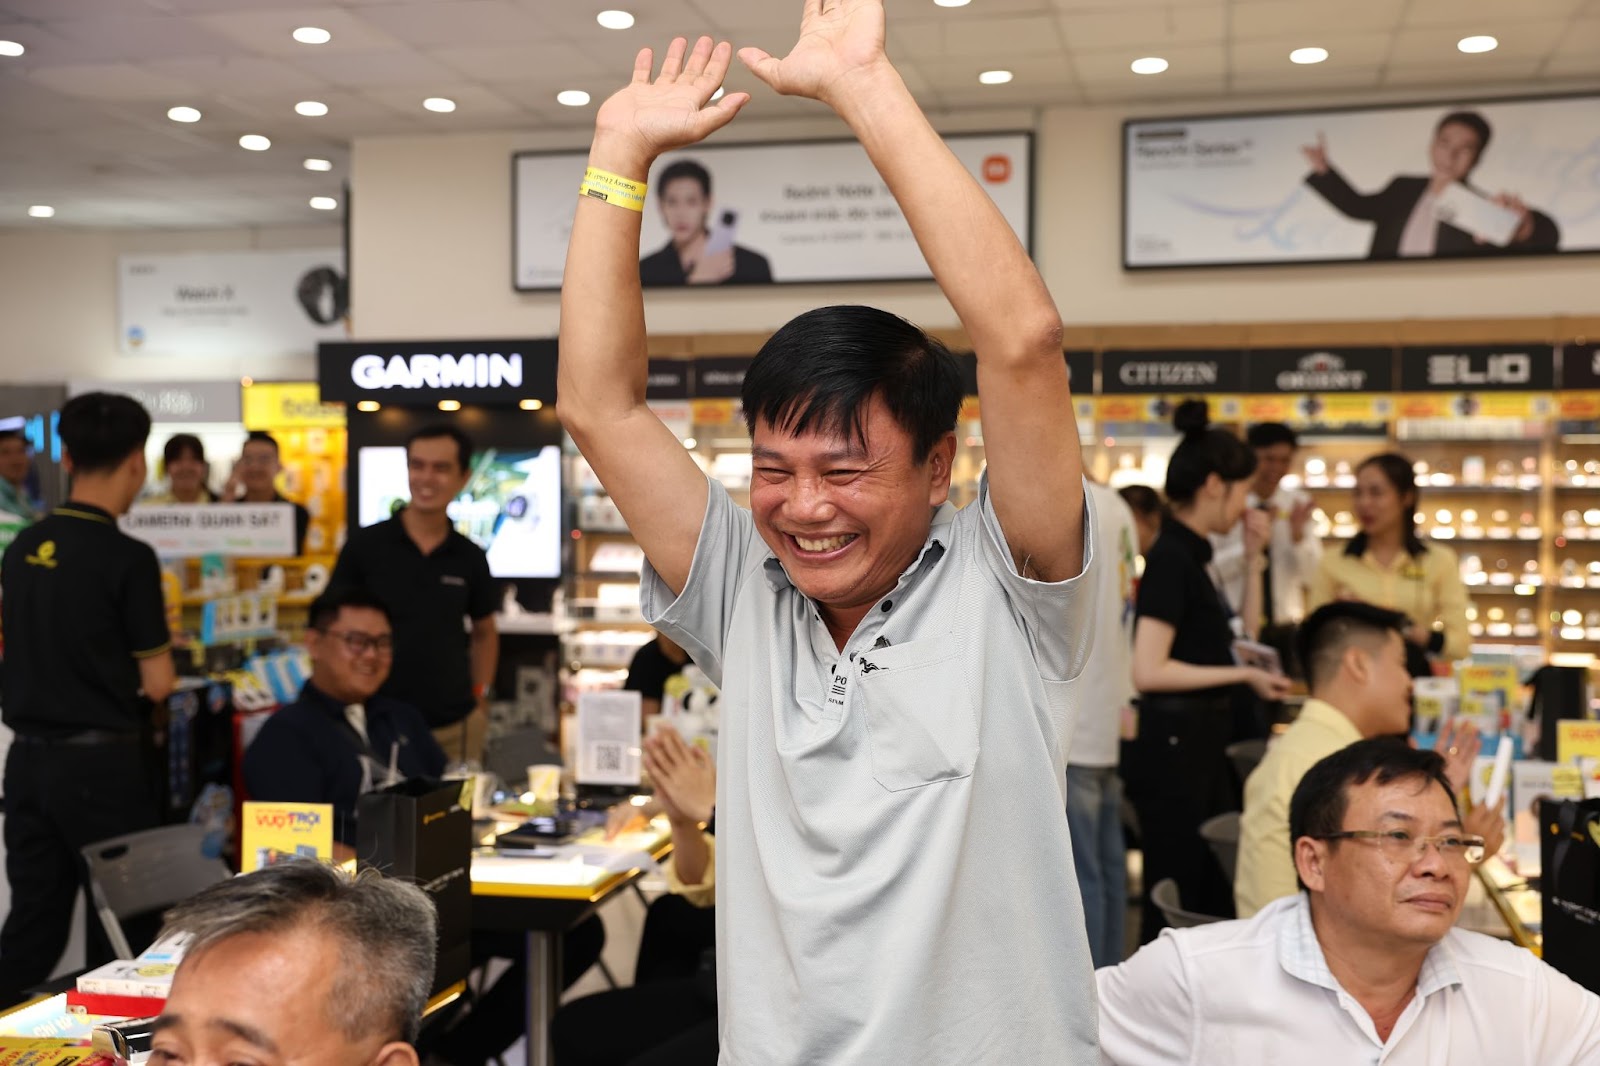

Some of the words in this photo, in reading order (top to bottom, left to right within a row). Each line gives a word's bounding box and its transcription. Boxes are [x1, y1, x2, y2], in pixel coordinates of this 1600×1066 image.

[614, 179, 637, 191] Galaxy
[350, 353, 523, 389] GARMIN
[1120, 362, 1217, 385] CITIZEN
[1429, 354, 1531, 384] ELIO
[1277, 370, 1366, 390] ORIENT
[127, 512, 192, 529] CAMERA
[200, 511, 243, 529] QUAN
